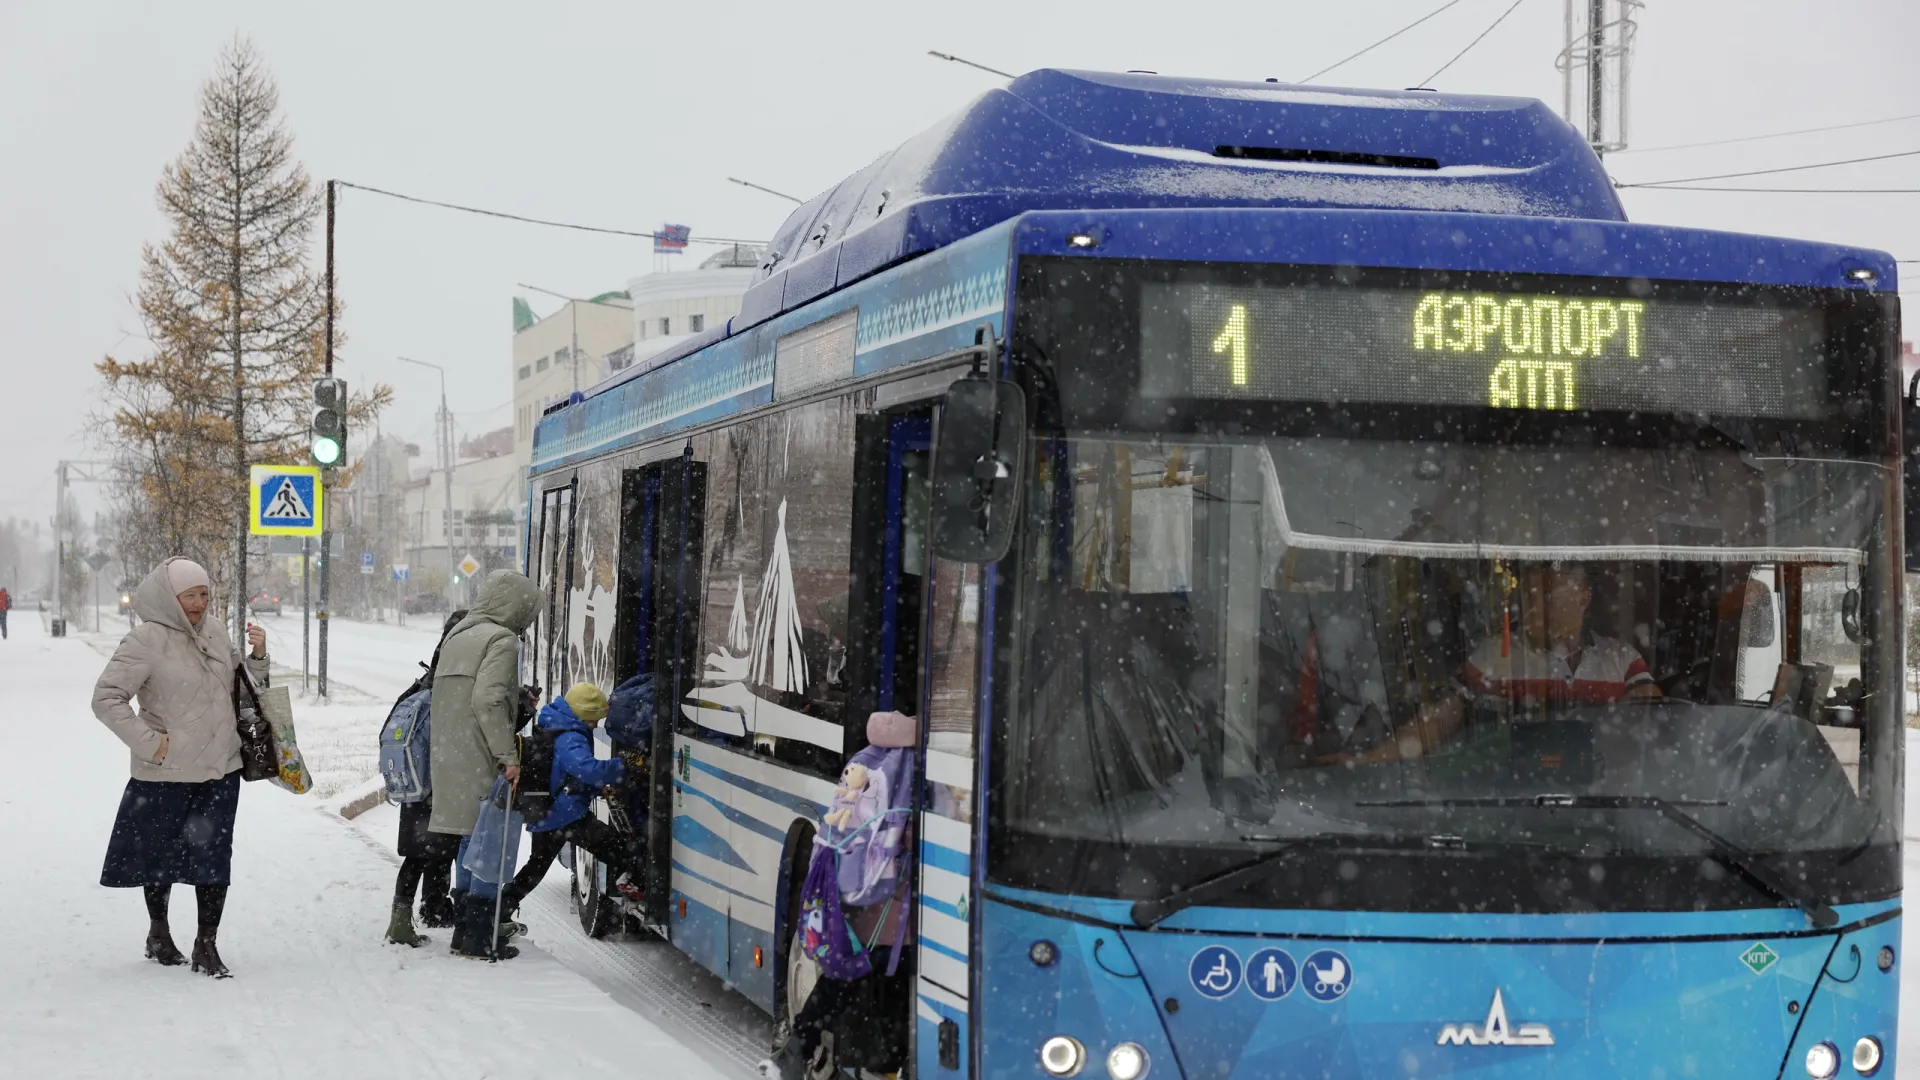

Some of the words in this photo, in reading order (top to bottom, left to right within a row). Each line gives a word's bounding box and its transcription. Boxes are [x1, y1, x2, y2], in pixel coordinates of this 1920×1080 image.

[1213, 305, 1246, 385] 1
[1414, 293, 1643, 358] АЭРОПОРТ
[1489, 359, 1574, 410] АТП
[1747, 951, 1770, 965] КПГ
